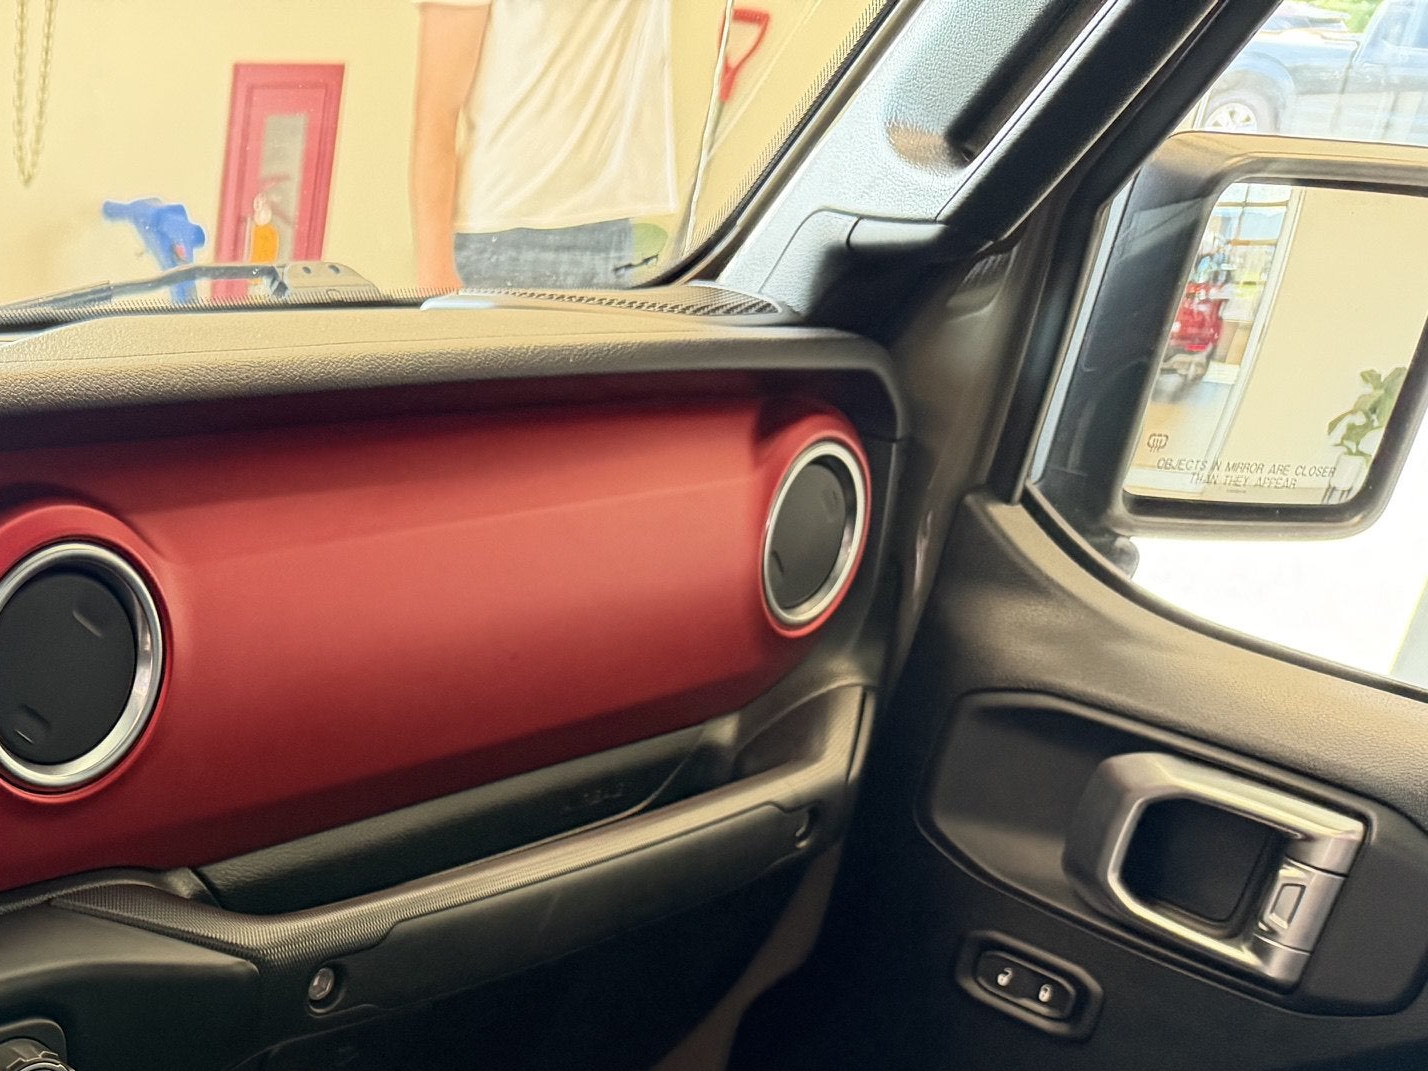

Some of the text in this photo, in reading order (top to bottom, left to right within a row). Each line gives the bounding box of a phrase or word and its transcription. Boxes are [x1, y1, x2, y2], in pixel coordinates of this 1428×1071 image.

[1157, 457, 1208, 470] OBJECTS
[1225, 461, 1265, 474] MIRROR
[1268, 463, 1291, 476] ARE
[1295, 465, 1337, 478] CLOSER
[1190, 471, 1297, 489] THAN THEY APPEAR
